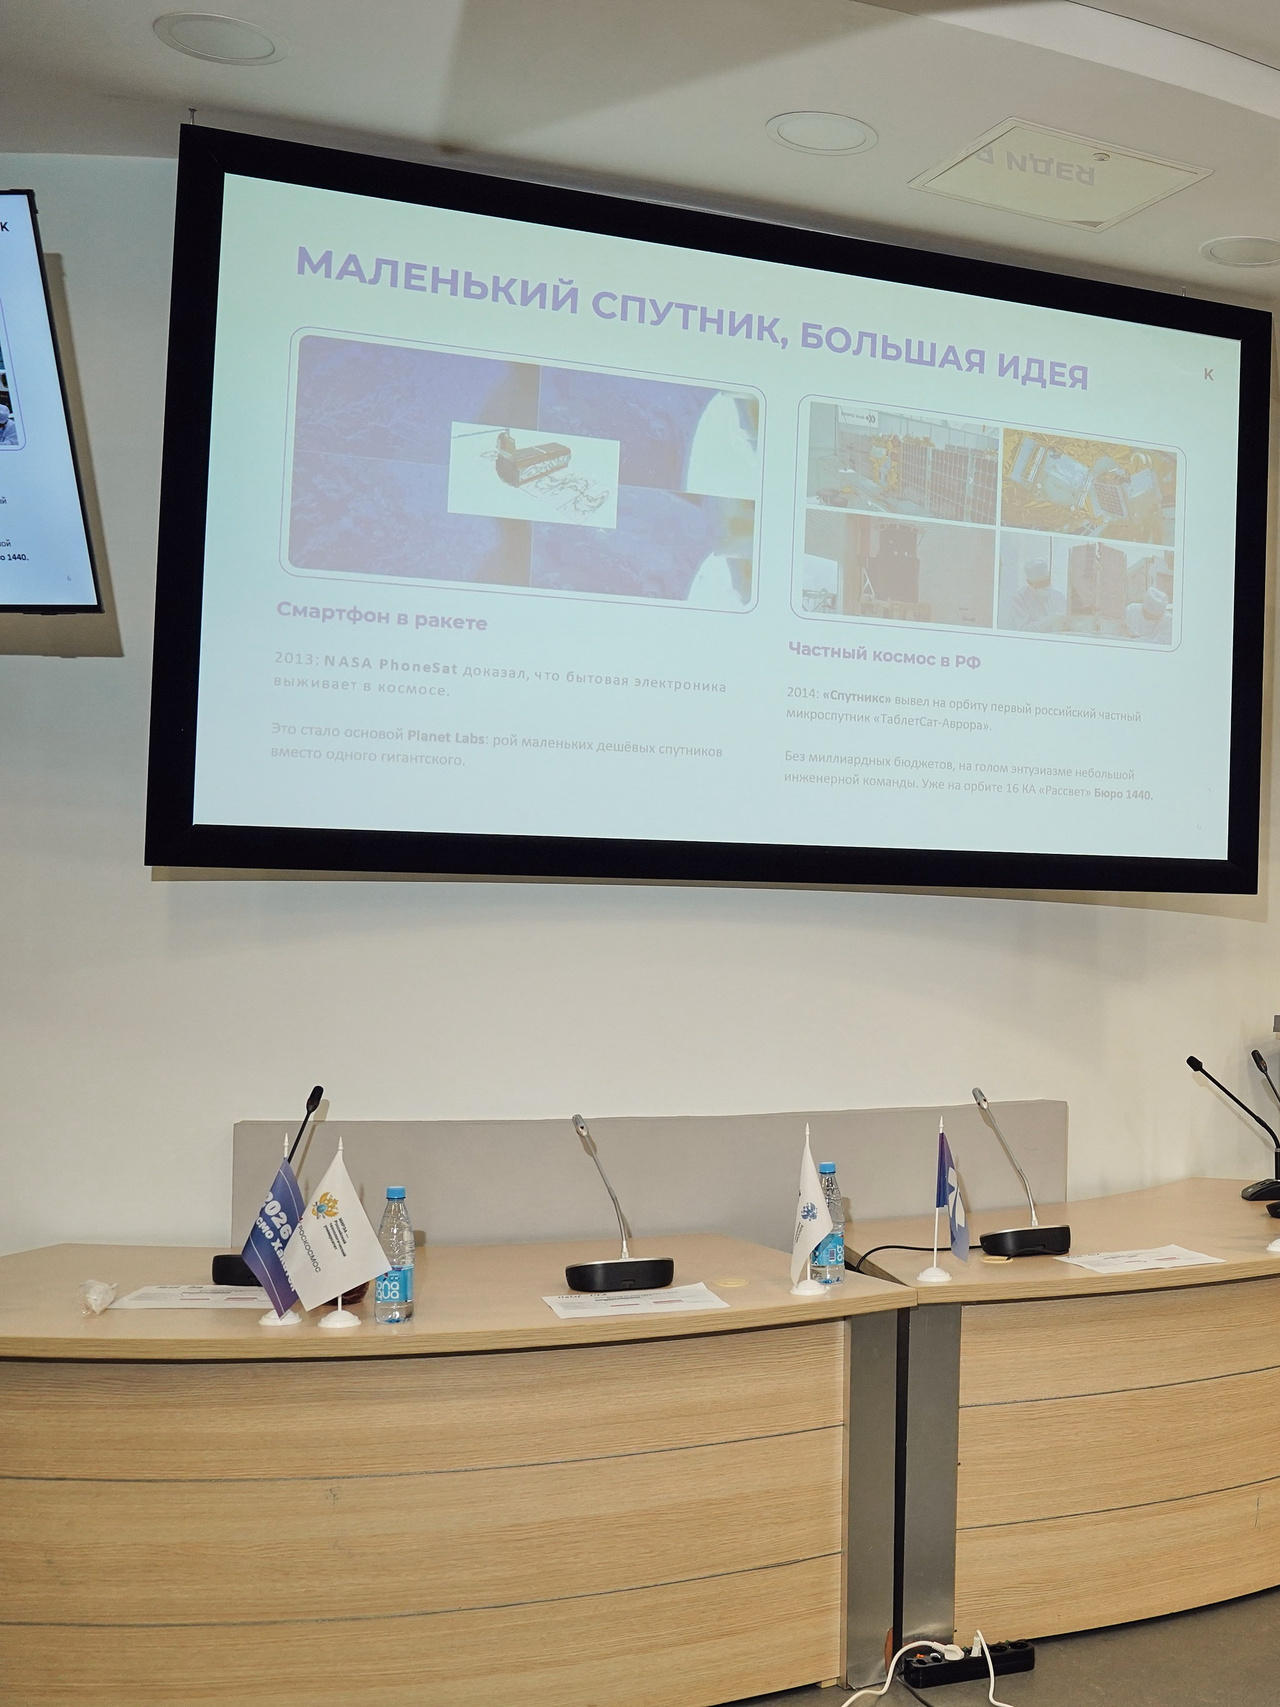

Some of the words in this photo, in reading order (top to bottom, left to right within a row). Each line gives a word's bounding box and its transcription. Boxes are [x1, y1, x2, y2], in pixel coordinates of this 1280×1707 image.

[297, 245, 579, 314] МАЛЕНЬКИЙ
[591, 291, 789, 350] СПУТНИК,
[801, 321, 986, 375] БОЛЬШАЯ
[997, 352, 1088, 391] ИДЕЯ
[276, 601, 390, 625] Смартфон
[396, 613, 409, 626] в
[415, 614, 488, 631] ракете
[788, 640, 867, 661] Частный
[872, 650, 936, 666] космос
[940, 656, 950, 667] в
[955, 654, 981, 670] РФ
[274, 676, 358, 691] выживает
[378, 683, 450, 697] космосе.
[275, 651, 319, 666] 2013:
[324, 655, 372, 669] NASA
[379, 658, 458, 675] PhoneSat
[462, 666, 530, 682] доказал,
[534, 671, 560, 682] что
[566, 670, 628, 686] бытовая
[634, 677, 726, 693] электроника
[787, 686, 819, 699] 2014:
[823, 689, 892, 704] «Спутникс»
[894, 696, 930, 707] вывел
[932, 699, 946, 708] на
[949, 698, 988, 713] орбиту
[990, 702, 1032, 715] первый
[1034, 705, 1096, 719] российский
[1098, 711, 1141, 722] частный
[786, 709, 870, 724] микроспутник
[873, 713, 992, 732] «ТаблетСат-Аврора».
[271, 722, 297, 735] Это
[300, 726, 340, 737] стало
[344, 727, 403, 740] основой
[407, 729, 452, 743] Planet
[455, 732, 489, 745] Labs:
[492, 733, 518, 748] рой
[521, 738, 594, 751] маленьких
[595, 740, 656, 754] дешёвых
[658, 745, 723, 758] спутников
[271, 747, 322, 759] вместо
[326, 750, 377, 762] одного
[381, 753, 465, 766] гигантского.
[785, 750, 805, 762] Без
[808, 753, 891, 767] миллиардных
[893, 756, 956, 772] бюджетов,
[958, 762, 972, 771] на
[975, 763, 1008, 773] голом
[1011, 765, 1073, 777] энтузиазме
[1075, 767, 1134, 780] небольшой
[784, 773, 860, 787] инженерной
[863, 777, 919, 790] команды.
[921, 778, 945, 790] Уже
[947, 781, 961, 790] на
[963, 781, 1003, 794] орбите
[1006, 783, 1019, 794] 16
[1022, 783, 1036, 794] КА
[1038, 784, 1091, 797] «Рассвет»
[1094, 787, 1124, 801] Бюро
[1125, 789, 1154, 800] 1440.
[298, 1225, 321, 1273] РОСКОСМОС
